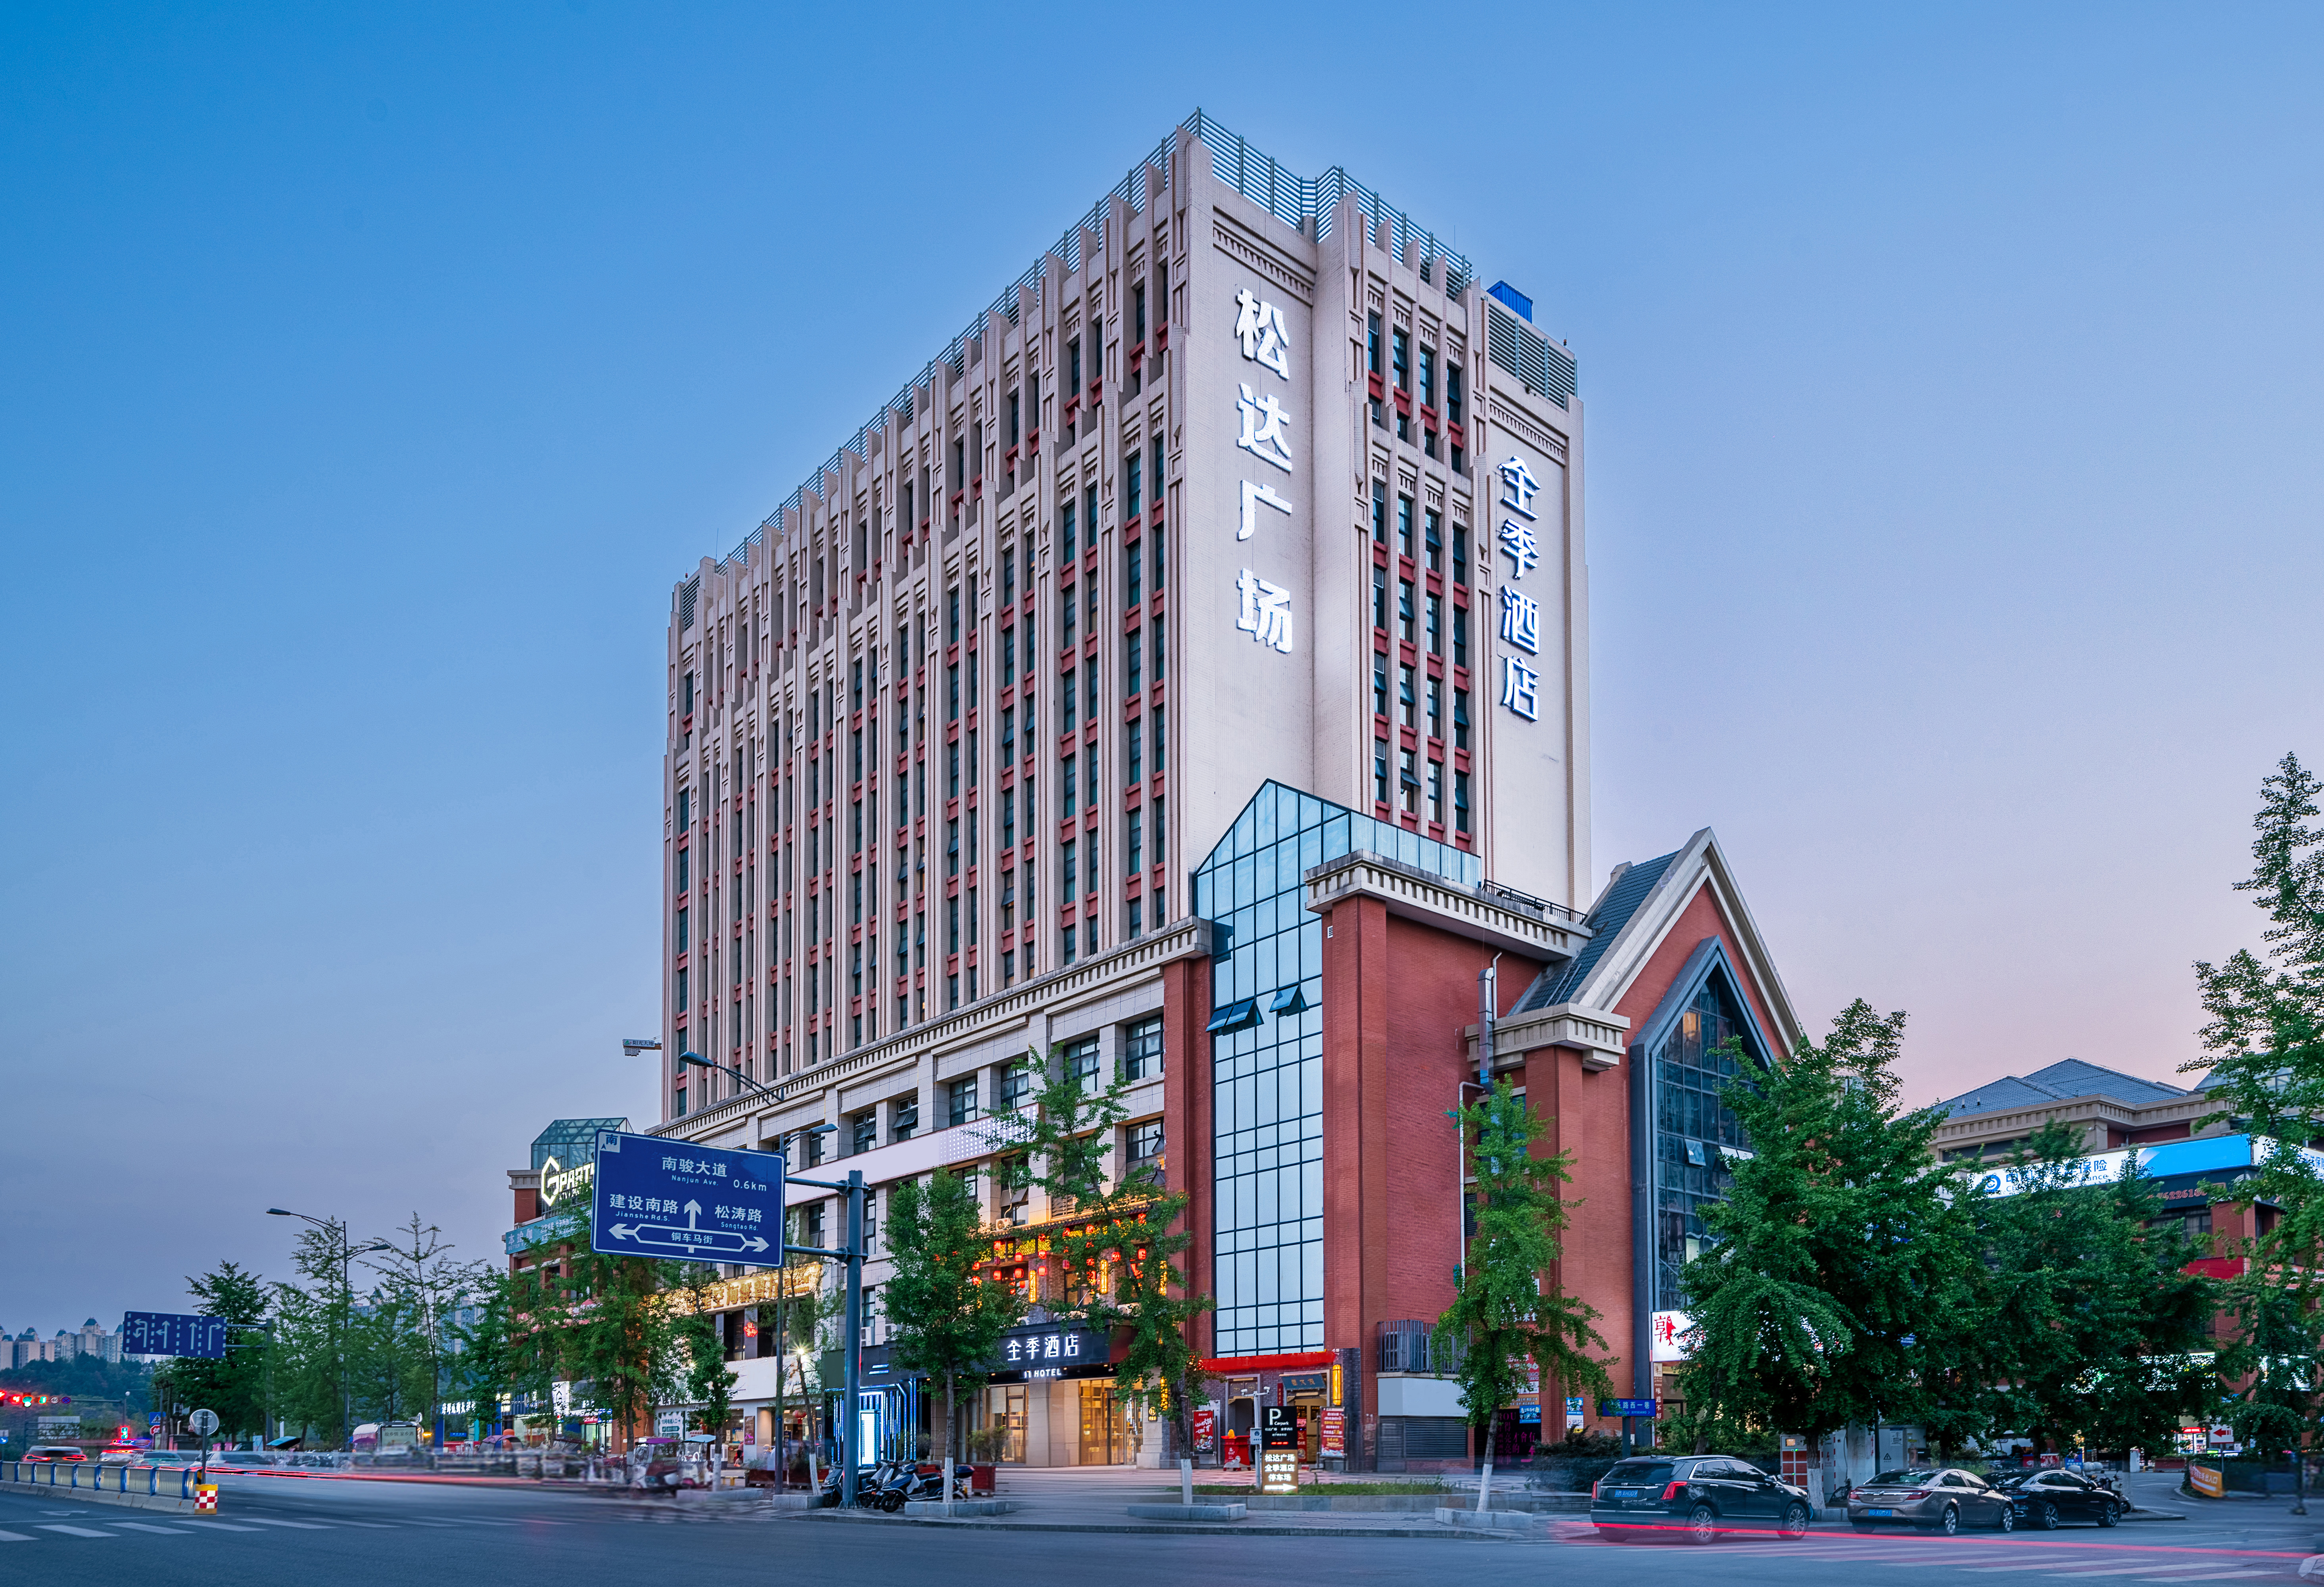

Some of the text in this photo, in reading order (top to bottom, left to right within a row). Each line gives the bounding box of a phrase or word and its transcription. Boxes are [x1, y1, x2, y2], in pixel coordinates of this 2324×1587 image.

[1235, 288, 1293, 653] 松达广场
[1498, 455, 1541, 722] 全季酒店
[606, 1134, 618, 1146] 南
[662, 1156, 727, 1177] 南骏大道
[672, 1175, 699, 1184] Nanjun
[733, 1180, 767, 1191] 0.6km
[610, 1193, 678, 1214] 建设南路
[615, 1211, 649, 1220] Jianshe
[715, 1205, 762, 1223] 松涛路
[721, 1222, 747, 1230] Songtao
[671, 1232, 713, 1245] 铜车马街
[1007, 1333, 1079, 1361] 全季酒店
[1034, 1368, 1062, 1378] HOTEL
[1269, 1408, 1282, 1426] P
[1264, 1454, 1296, 1462] 松达广场
[1264, 1464, 1295, 1472] 全季酒店
